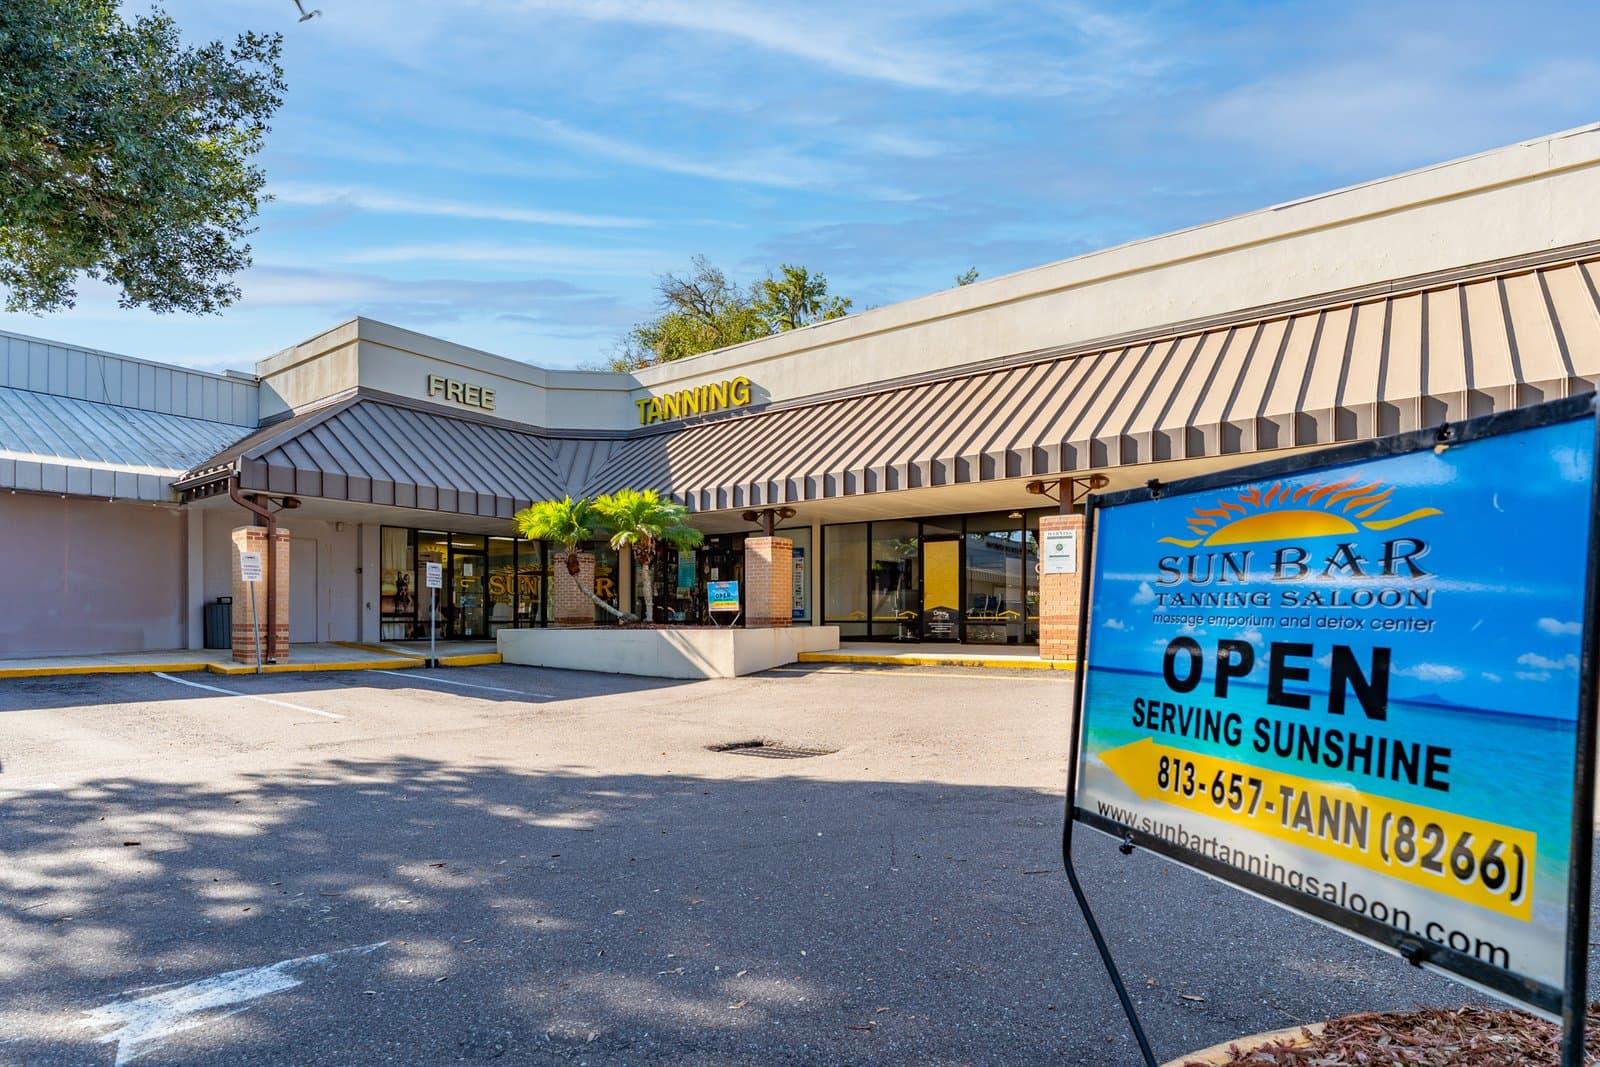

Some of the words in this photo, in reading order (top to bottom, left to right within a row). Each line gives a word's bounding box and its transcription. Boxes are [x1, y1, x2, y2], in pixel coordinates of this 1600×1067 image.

[427, 374, 497, 411] FREE
[635, 376, 752, 425] TANNING
[1155, 550, 1255, 587] SUN
[1271, 537, 1438, 586] BAR
[1152, 613, 1204, 627] massage
[1207, 615, 1275, 628] emporium
[1280, 614, 1312, 629] and
[1316, 615, 1365, 631] detox
[1371, 616, 1437, 633] center
[1156, 591, 1272, 609] TANNING
[1280, 588, 1433, 609] SALOON
[1163, 636, 1392, 721] OPEN
[1132, 697, 1242, 747] SERVING
[1253, 718, 1453, 792] SUNSHINE
[1157, 755, 1370, 854] 813-657-TANN
[1380, 811, 1527, 907] (8266)
[1097, 800, 1511, 970] www.sunbartanningsaloon.com
